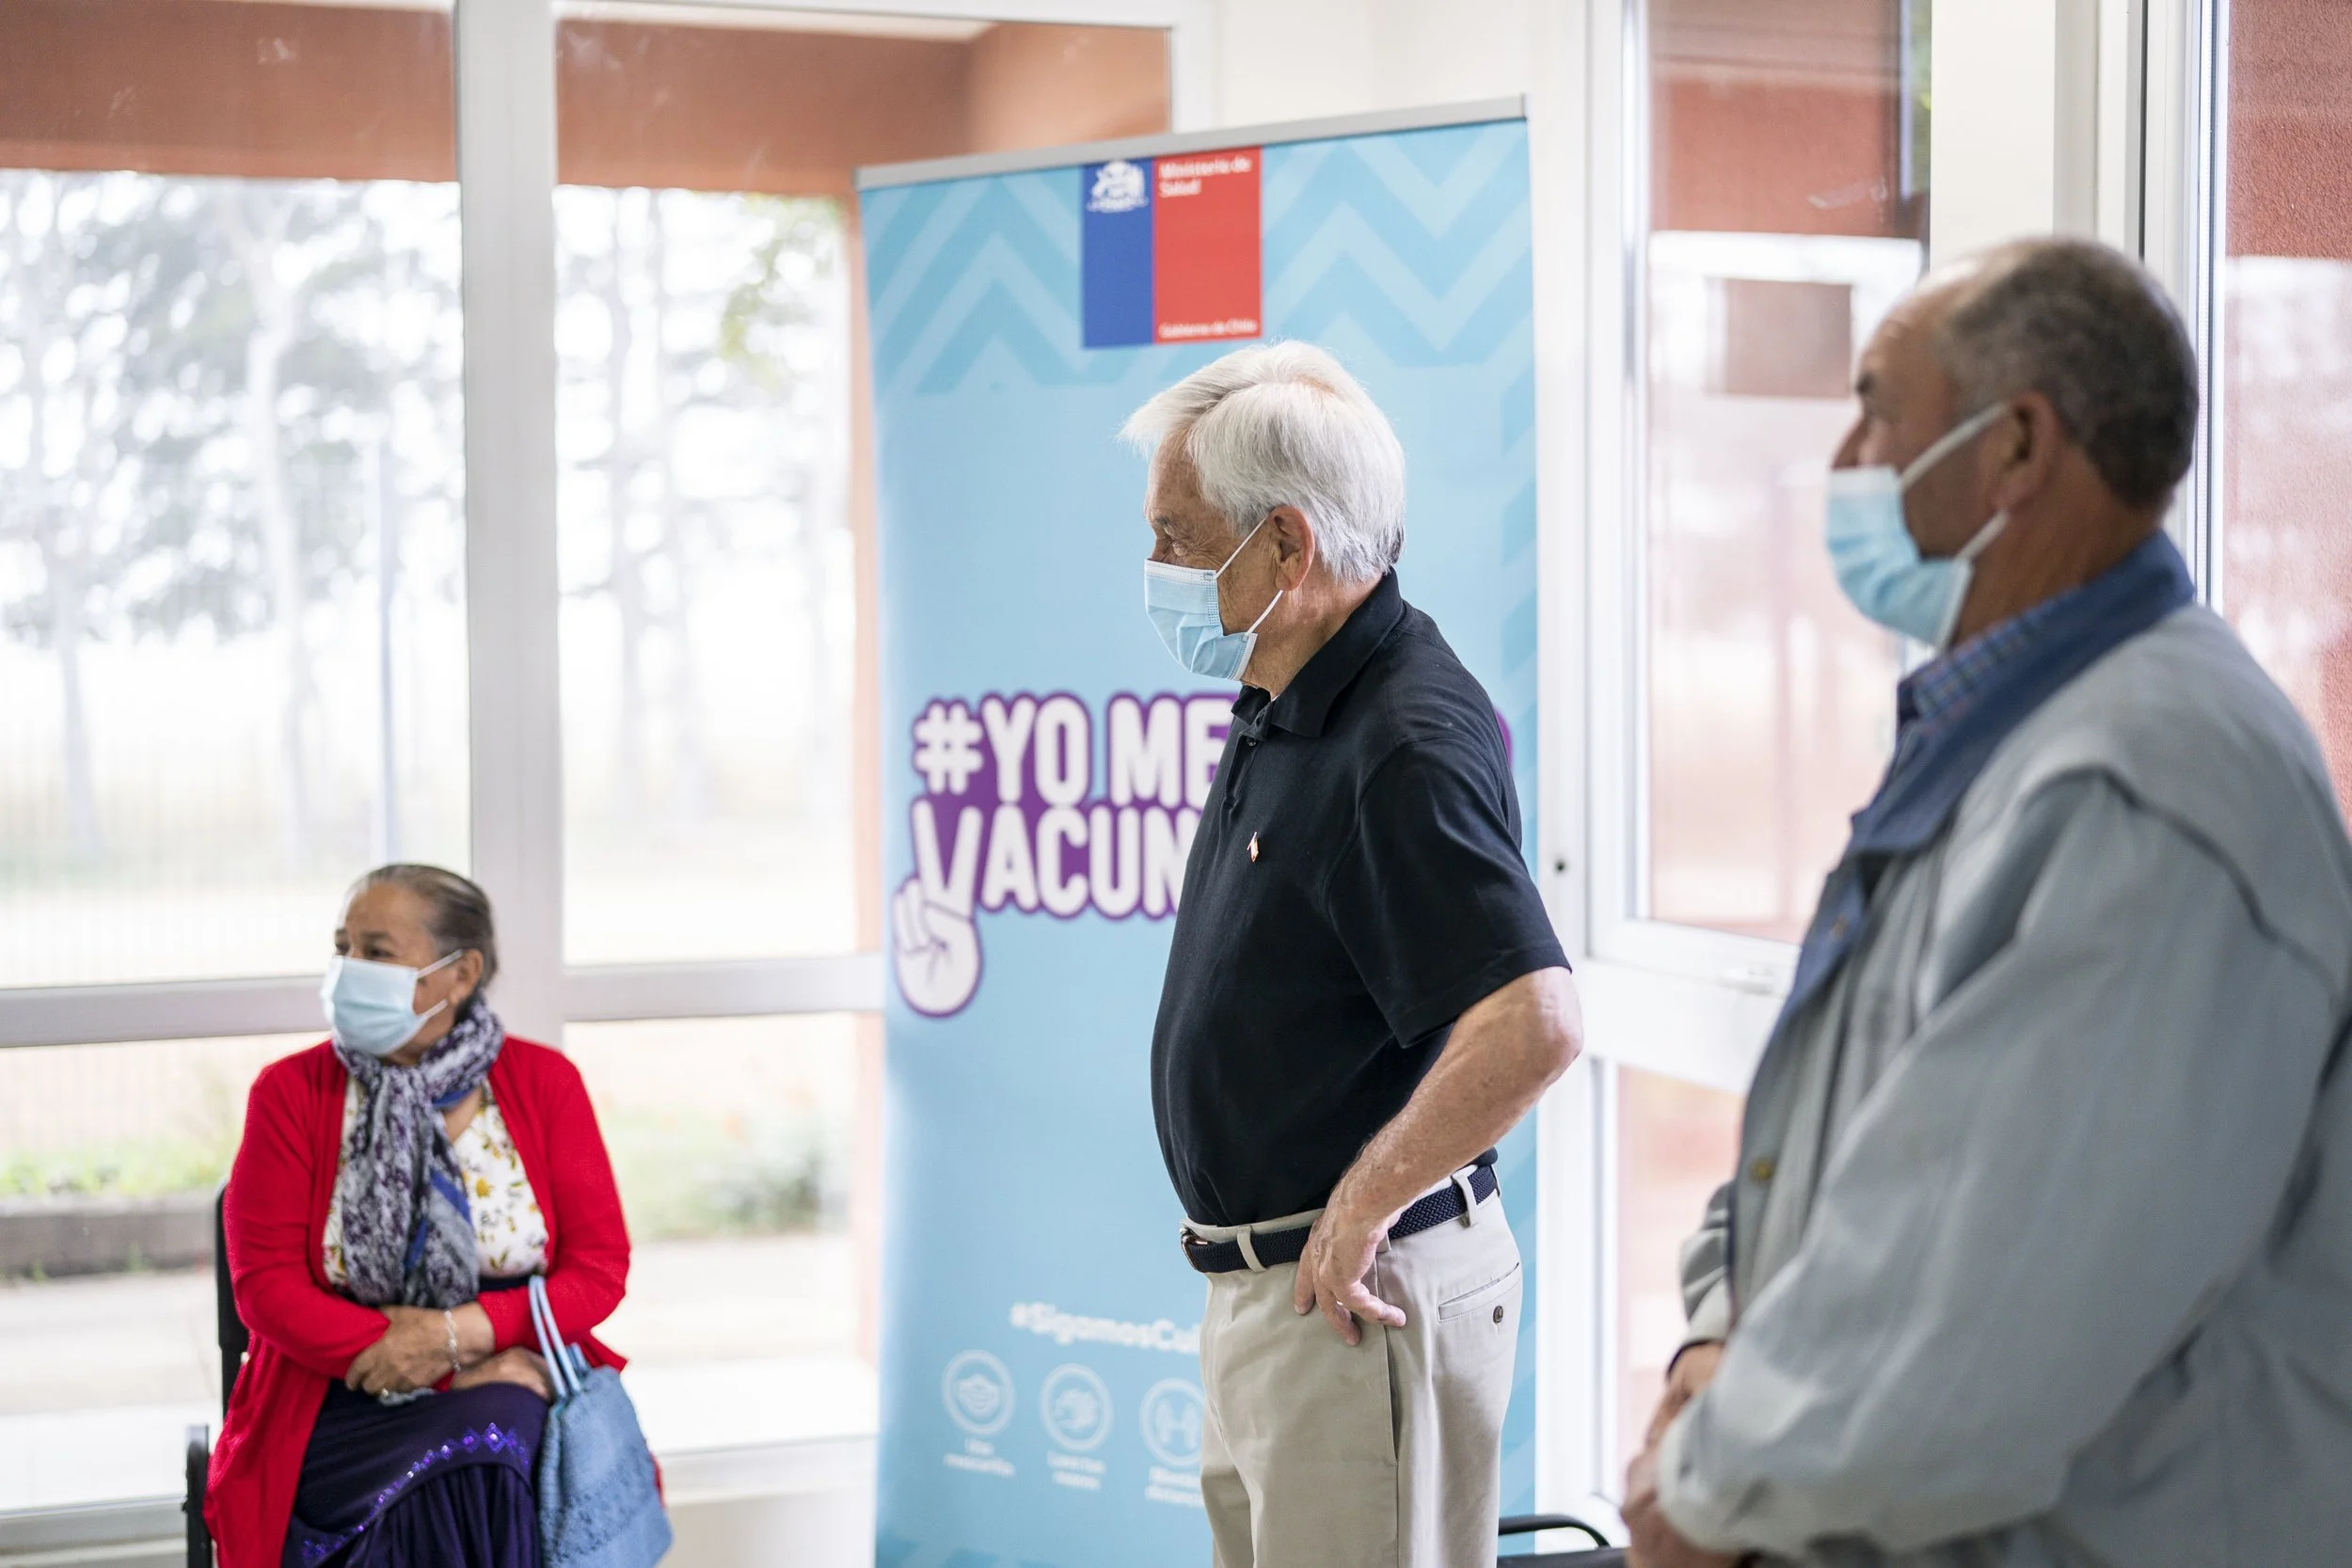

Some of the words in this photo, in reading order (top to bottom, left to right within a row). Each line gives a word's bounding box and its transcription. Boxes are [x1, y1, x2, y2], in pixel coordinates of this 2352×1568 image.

[1158, 179, 1201, 198] Salud
[913, 696, 1089, 807] #YO
[1110, 695, 1233, 809] ME
